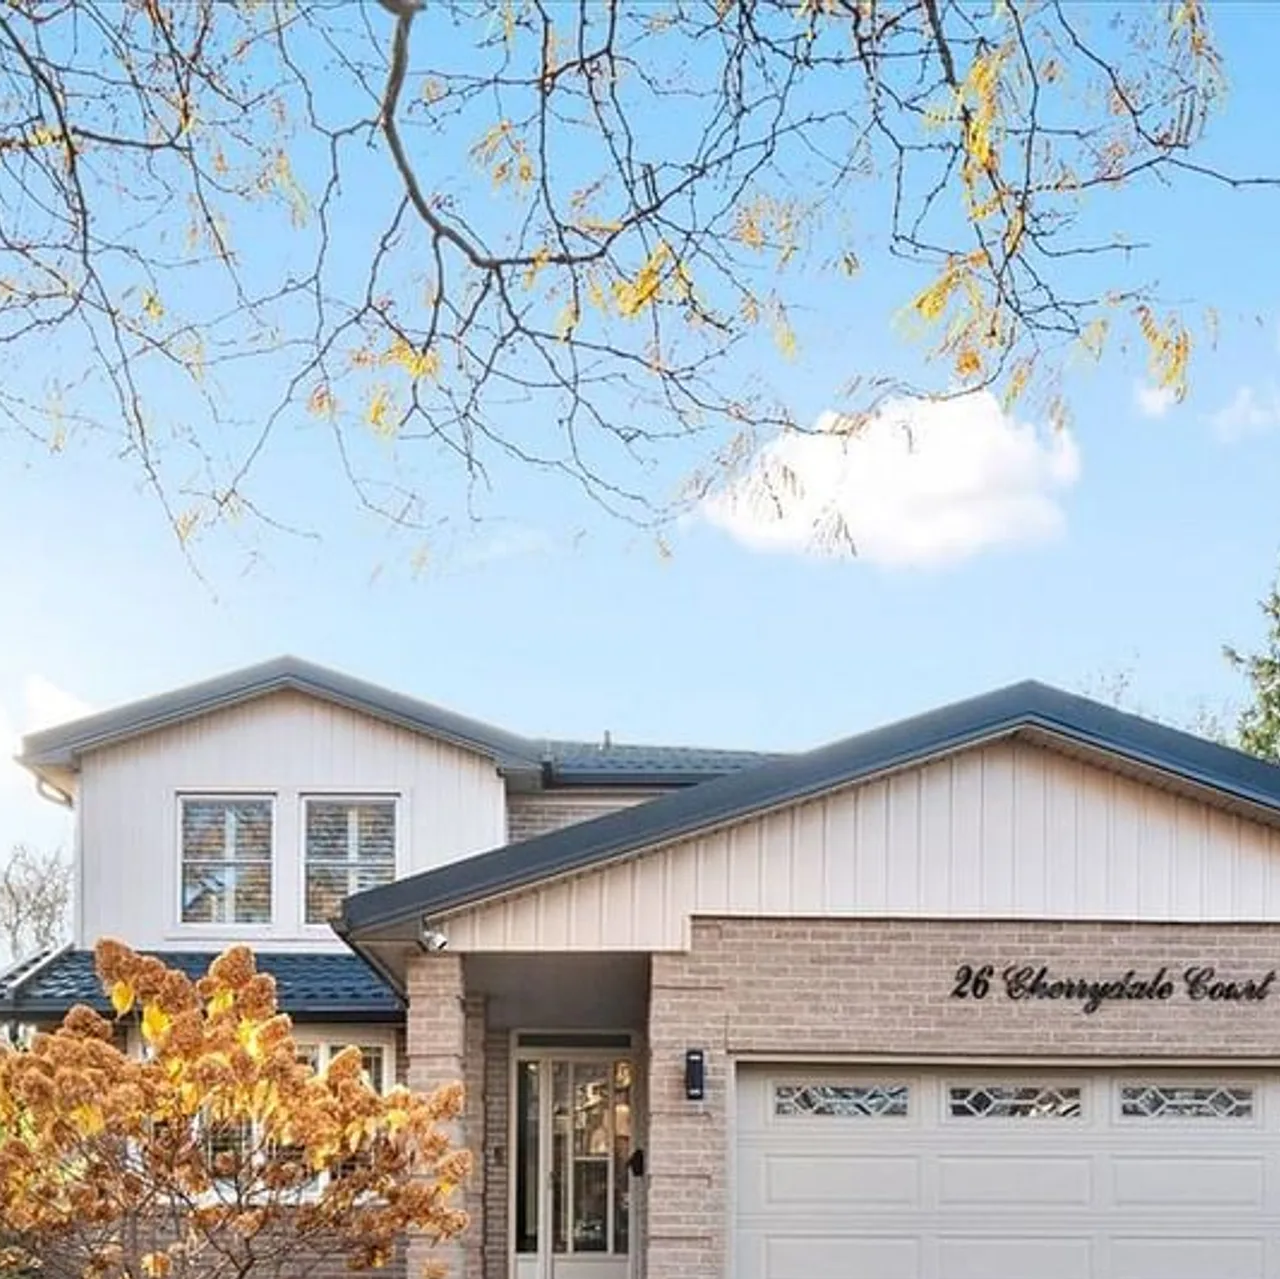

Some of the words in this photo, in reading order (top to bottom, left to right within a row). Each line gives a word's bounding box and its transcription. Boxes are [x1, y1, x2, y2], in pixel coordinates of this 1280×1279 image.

[949, 964, 994, 1000] 26
[1002, 964, 1174, 1014] Cherrydale
[1184, 965, 1277, 1001] Court
